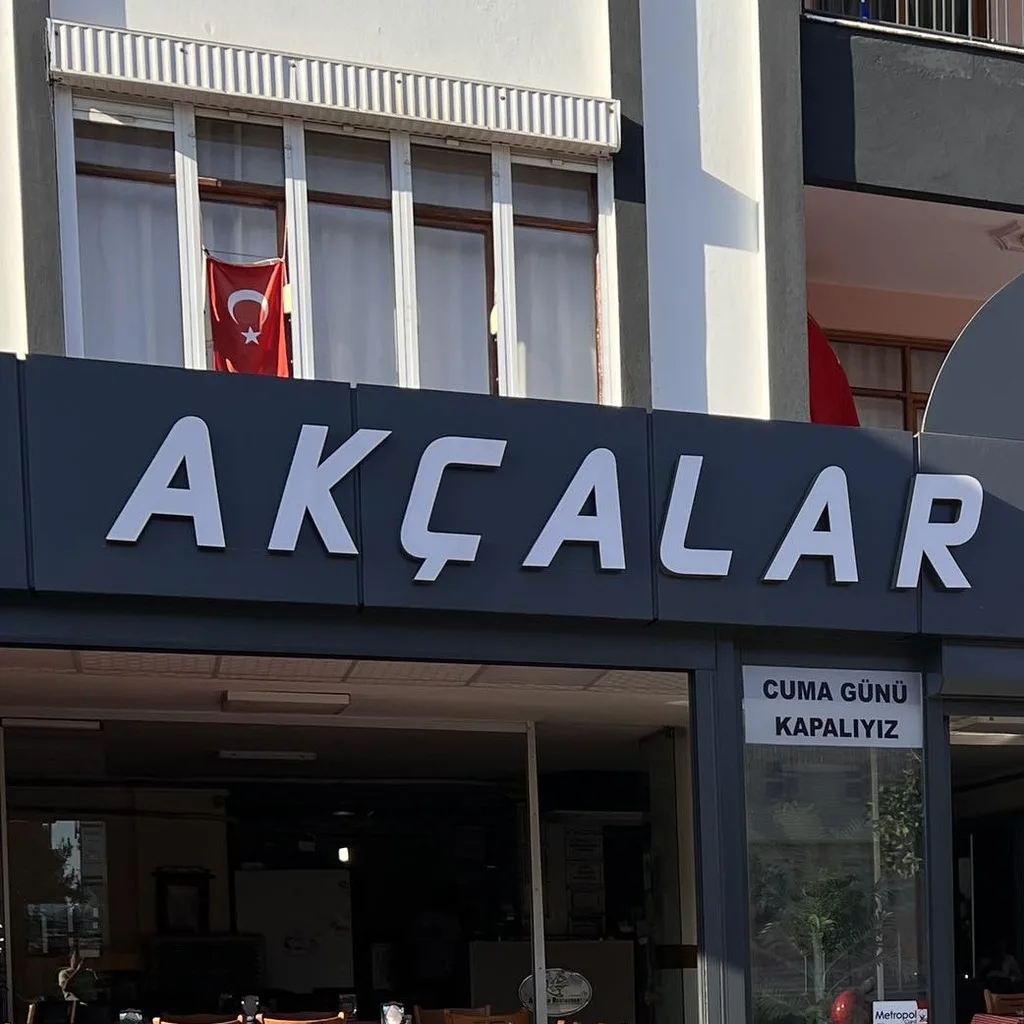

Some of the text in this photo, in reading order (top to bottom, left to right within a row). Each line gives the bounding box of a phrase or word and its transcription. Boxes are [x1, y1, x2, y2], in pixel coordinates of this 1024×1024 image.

[105, 415, 984, 589] AKÇALAR
[763, 679, 907, 704] CUMA GÜNÜ
[775, 716, 899, 739] KAPALIYIZ
[875, 1010, 917, 1021] Metropol
